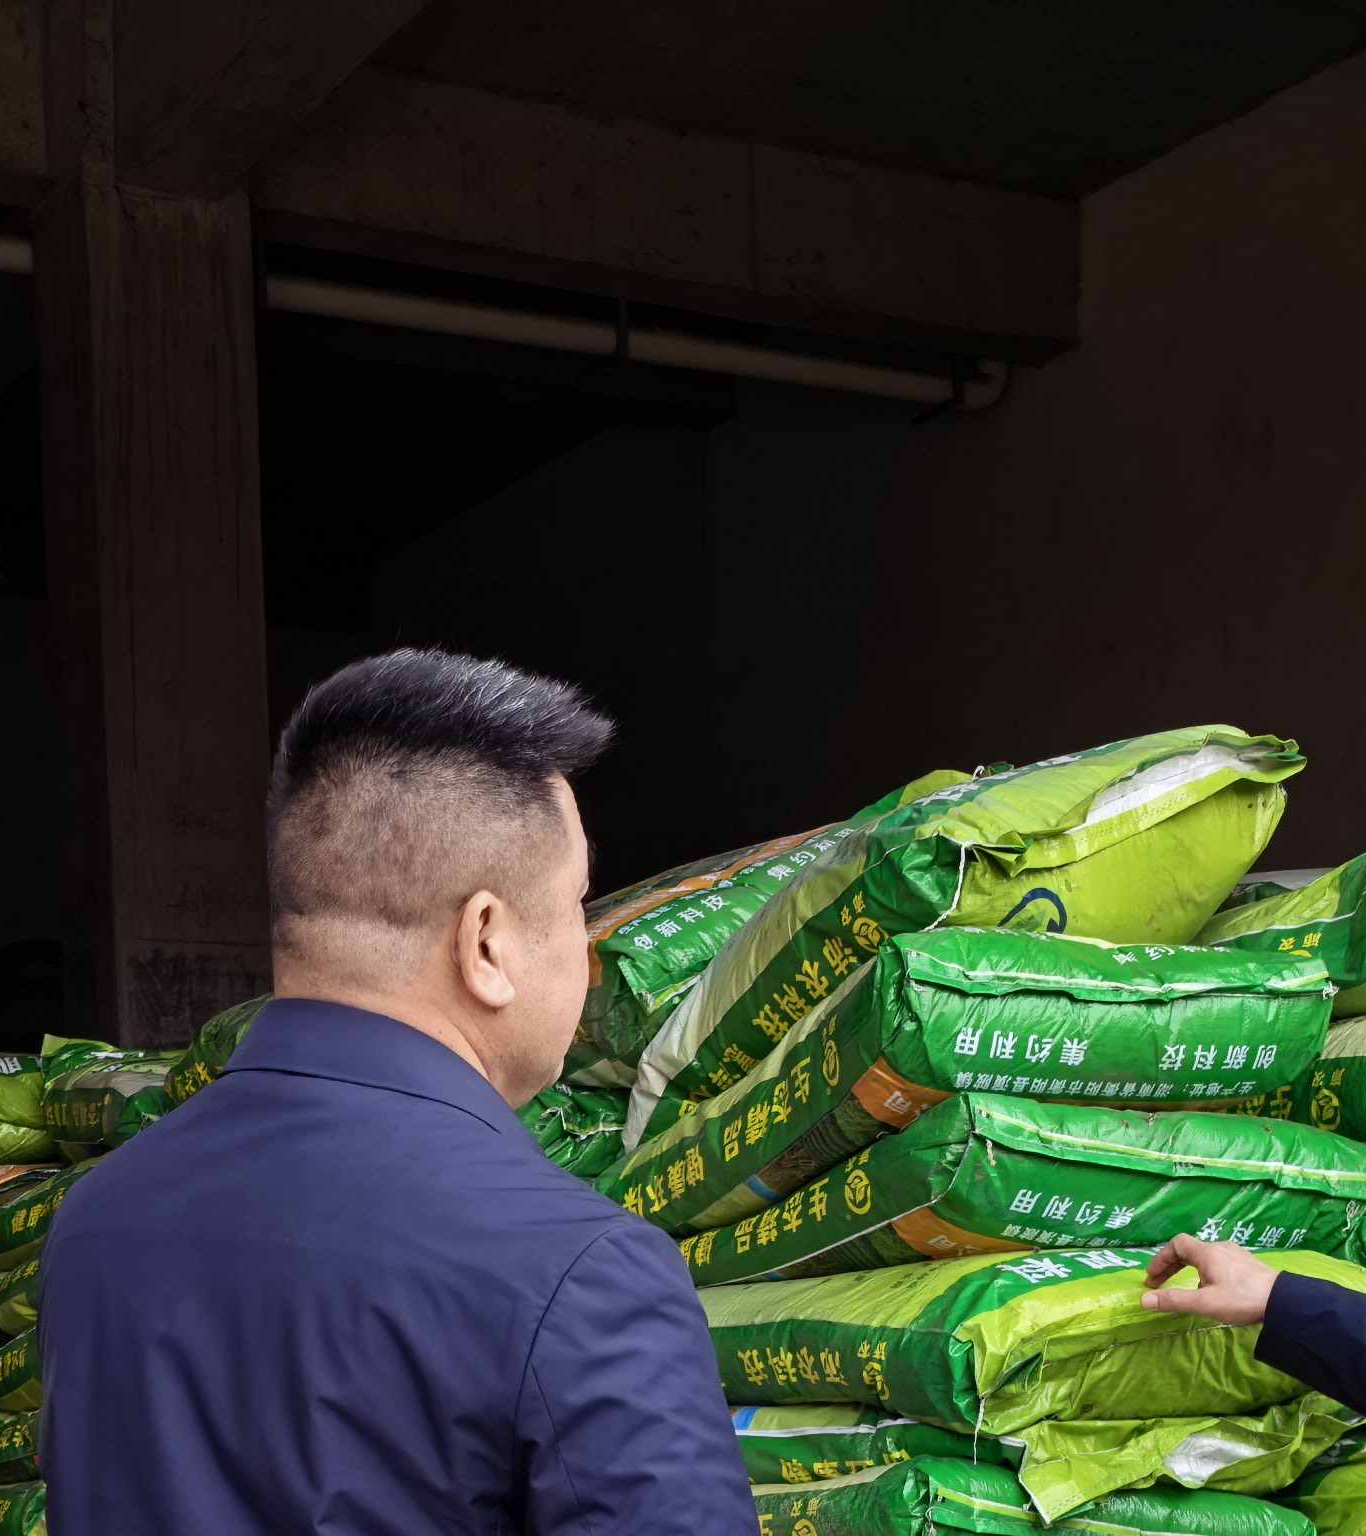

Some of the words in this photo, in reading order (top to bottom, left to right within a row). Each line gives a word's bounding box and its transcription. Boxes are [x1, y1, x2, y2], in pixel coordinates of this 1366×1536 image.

[633, 892, 731, 951] 创新科技
[751, 936, 859, 1043] 沛农科技
[952, 1027, 1088, 1066] 集约利用
[1157, 1042, 1279, 1071] 创新科技
[723, 1055, 811, 1163] 生态精品
[734, 1177, 830, 1255] 生态精品
[1008, 1189, 1136, 1229] 集约利用
[996, 1247, 1167, 1284] 肥料
